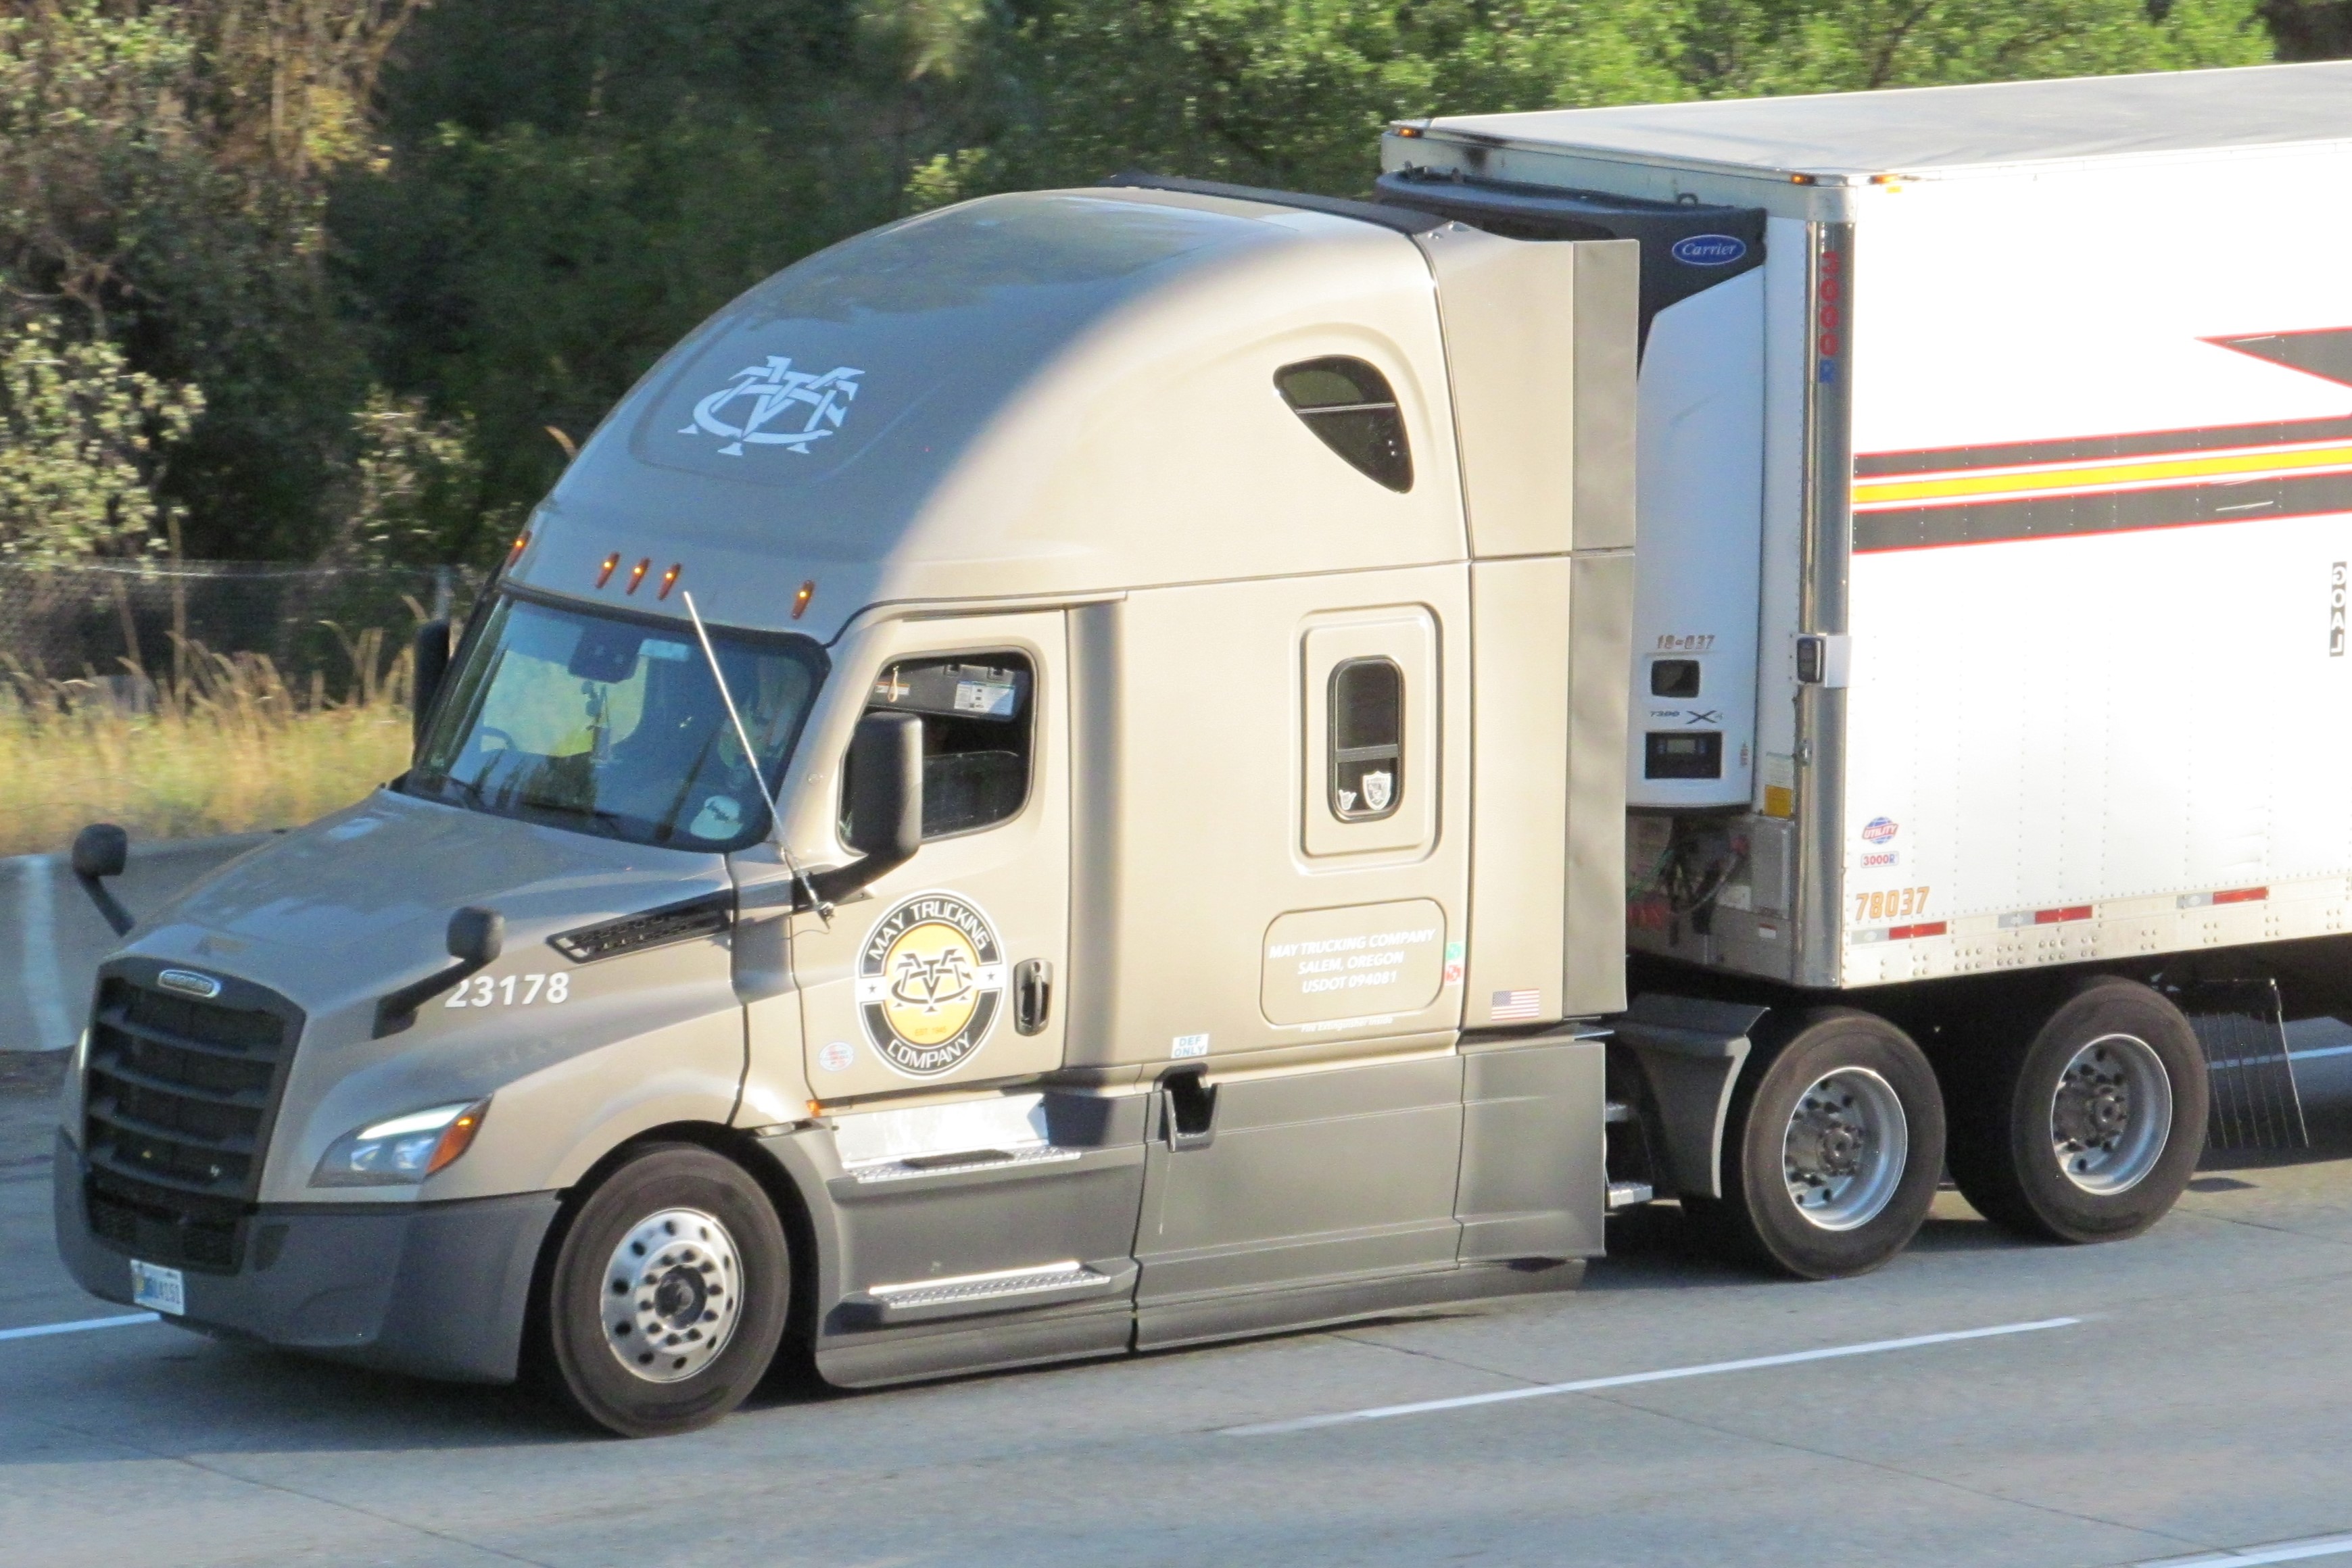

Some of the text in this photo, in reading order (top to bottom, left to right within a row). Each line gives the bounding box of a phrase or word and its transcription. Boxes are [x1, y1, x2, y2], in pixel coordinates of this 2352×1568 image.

[1681, 243, 1737, 256] Carrier
[1863, 824, 1897, 839] UTILITY
[1863, 854, 1895, 866] 3000R
[1855, 886, 1930, 921] 78037
[868, 901, 990, 960] MAY TRUCKING
[1270, 929, 1436, 958] MAY TRUCKING COMPANY
[1297, 951, 1405, 975] SALEM, OREGON
[444, 972, 569, 1008] 23178
[1302, 976, 1347, 993] USDOT
[1301, 1016, 1393, 1033] Fire Extinguisher Inside
[1179, 1036, 1201, 1046] DEF
[887, 1031, 971, 1069] COMPANY
[1174, 1046, 1204, 1056] ONLY
